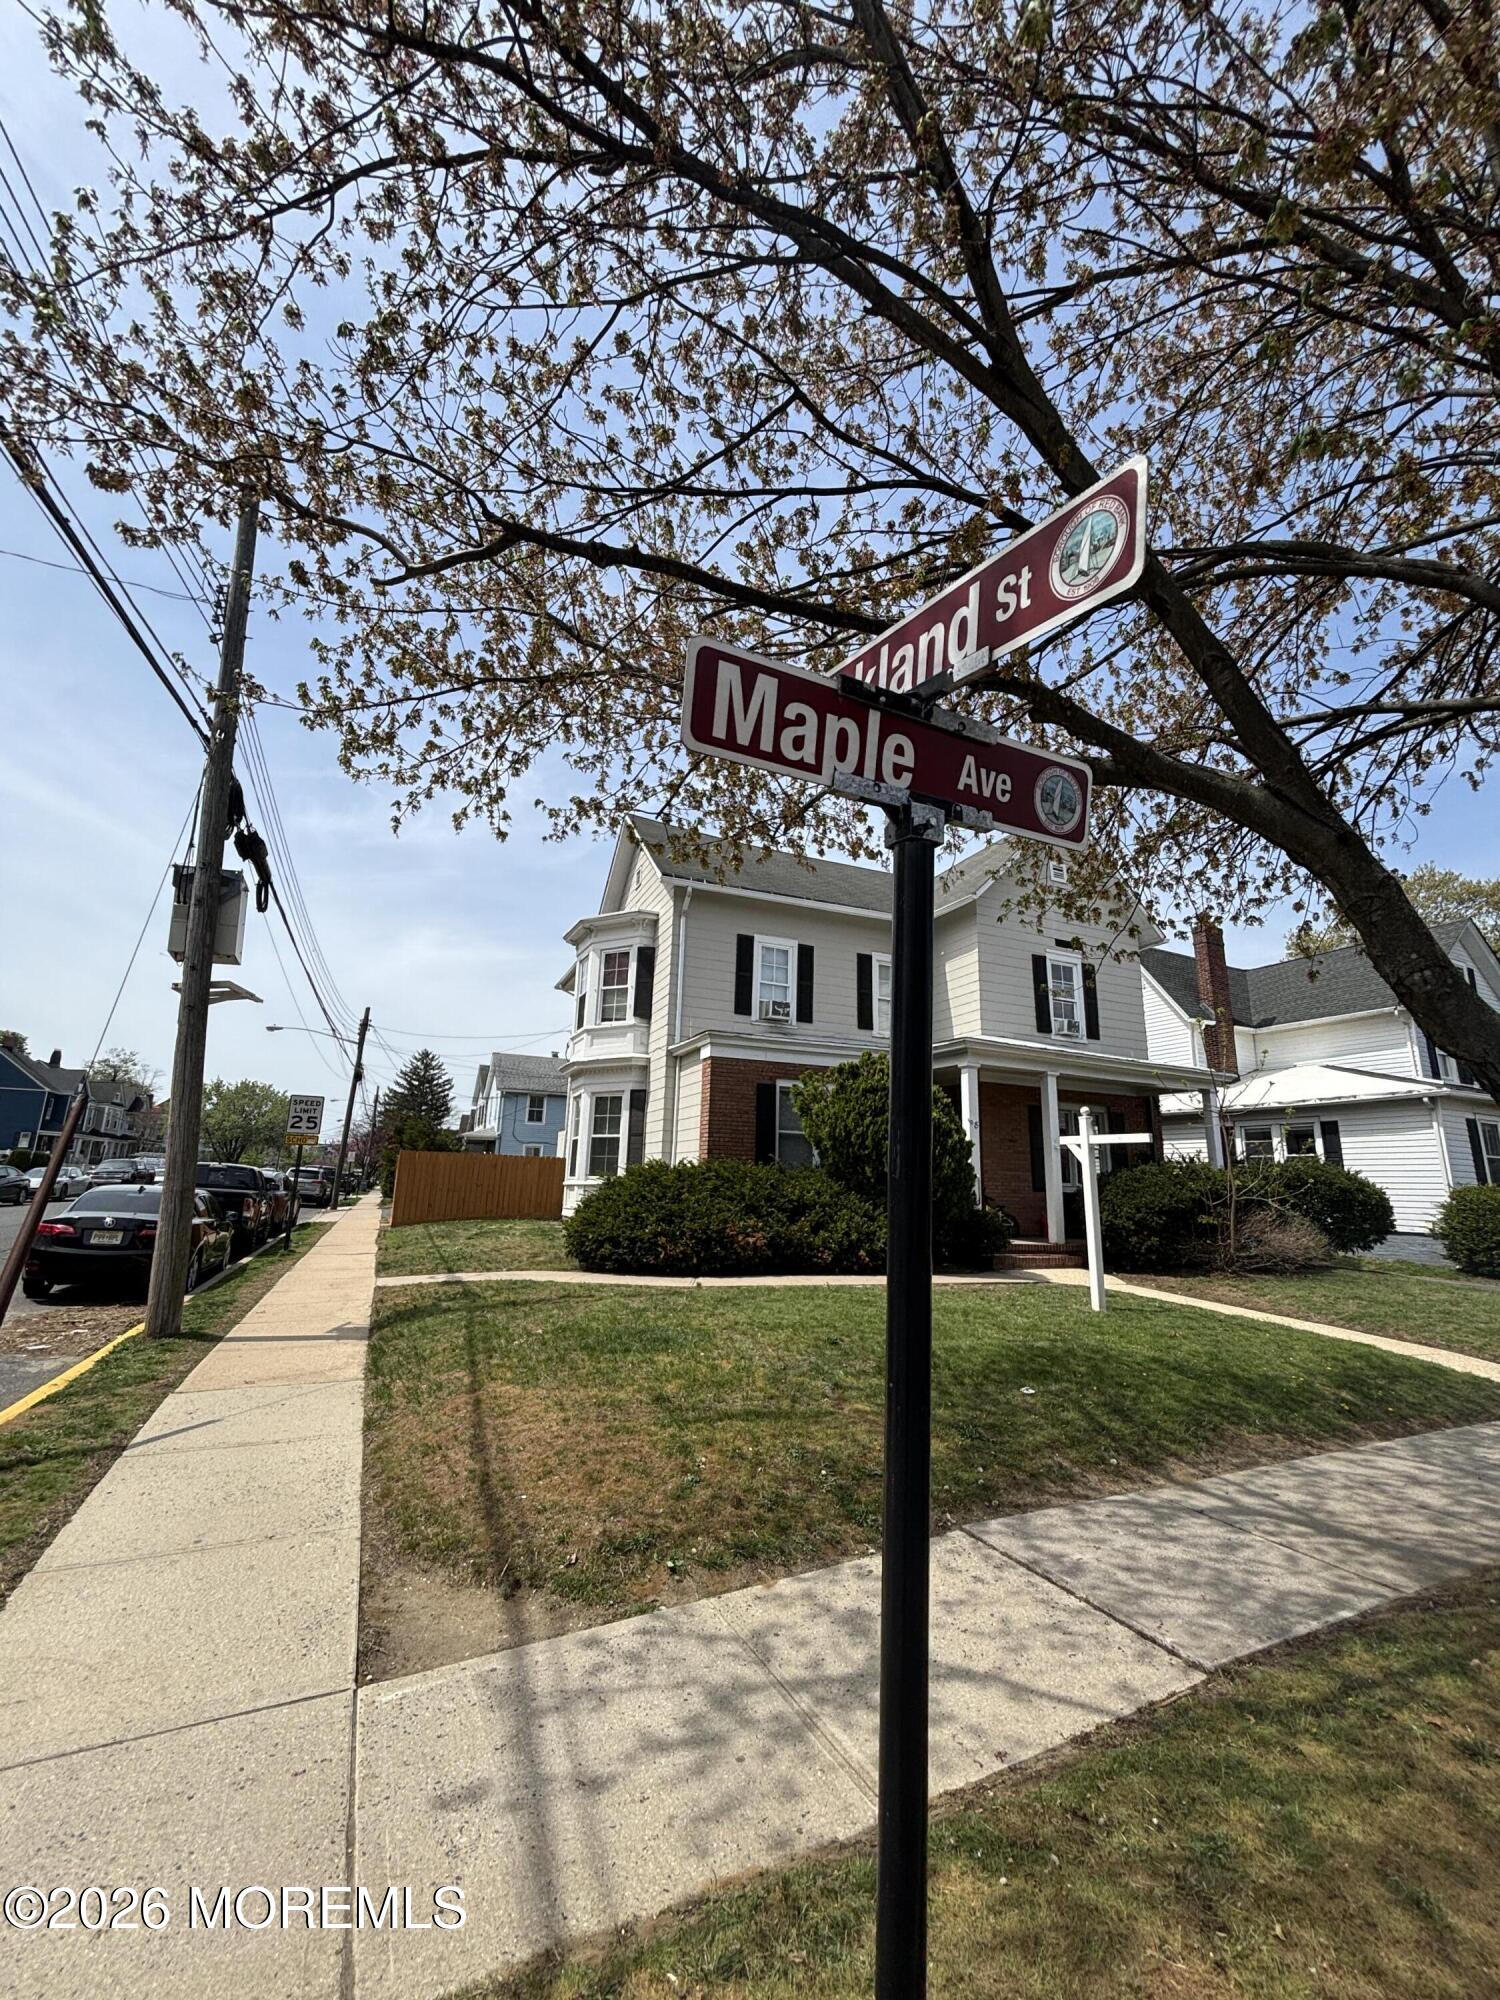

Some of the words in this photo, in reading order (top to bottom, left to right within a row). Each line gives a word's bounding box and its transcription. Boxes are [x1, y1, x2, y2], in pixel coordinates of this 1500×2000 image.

[995, 565, 1032, 622] St
[711, 659, 915, 790] Maple
[957, 754, 1012, 803] Ave
[292, 1099, 321, 1107] SPEED
[294, 1107, 318, 1115] LIMIT
[290, 1115, 318, 1130] 25
